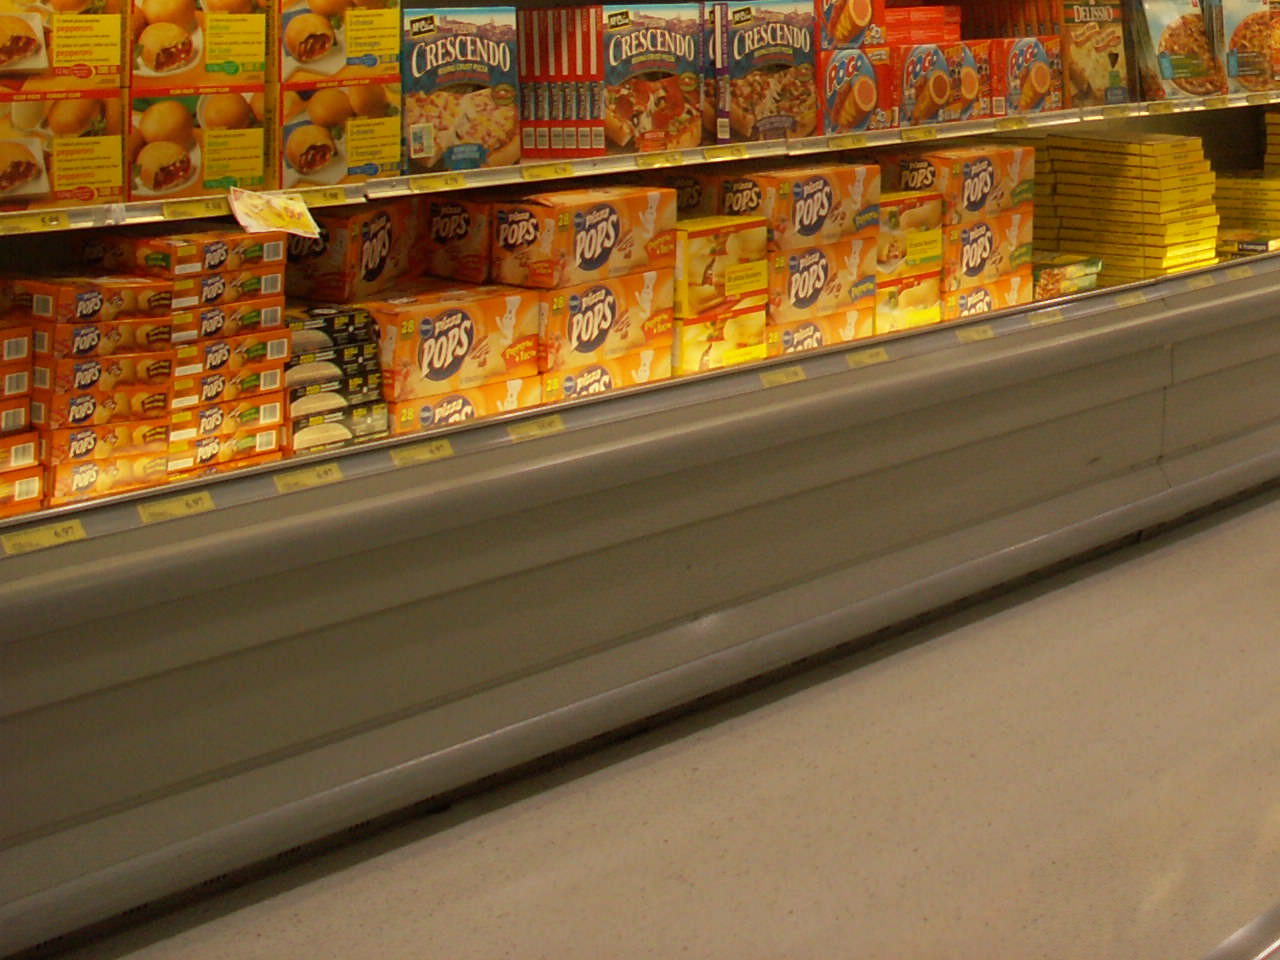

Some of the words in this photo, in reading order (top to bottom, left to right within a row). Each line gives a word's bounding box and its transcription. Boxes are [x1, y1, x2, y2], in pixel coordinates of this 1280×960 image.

[1073, 4, 1114, 22] DELISSIO
[412, 35, 511, 78] CRESCENDO
[609, 28, 695, 66] CRESCENDO
[733, 23, 811, 60] CRESCENDO
[901, 167, 936, 191] POPS
[963, 168, 993, 209] POPS
[725, 188, 761, 213] POPS
[795, 186, 832, 233] POPS
[432, 213, 468, 238] POPS
[499, 219, 538, 249] POPS
[575, 215, 618, 267] POPS
[361, 223, 392, 279] POPS
[962, 232, 992, 275] POPS
[790, 258, 827, 306] POPS
[572, 296, 614, 351] POPS
[421, 319, 472, 377] POPS
